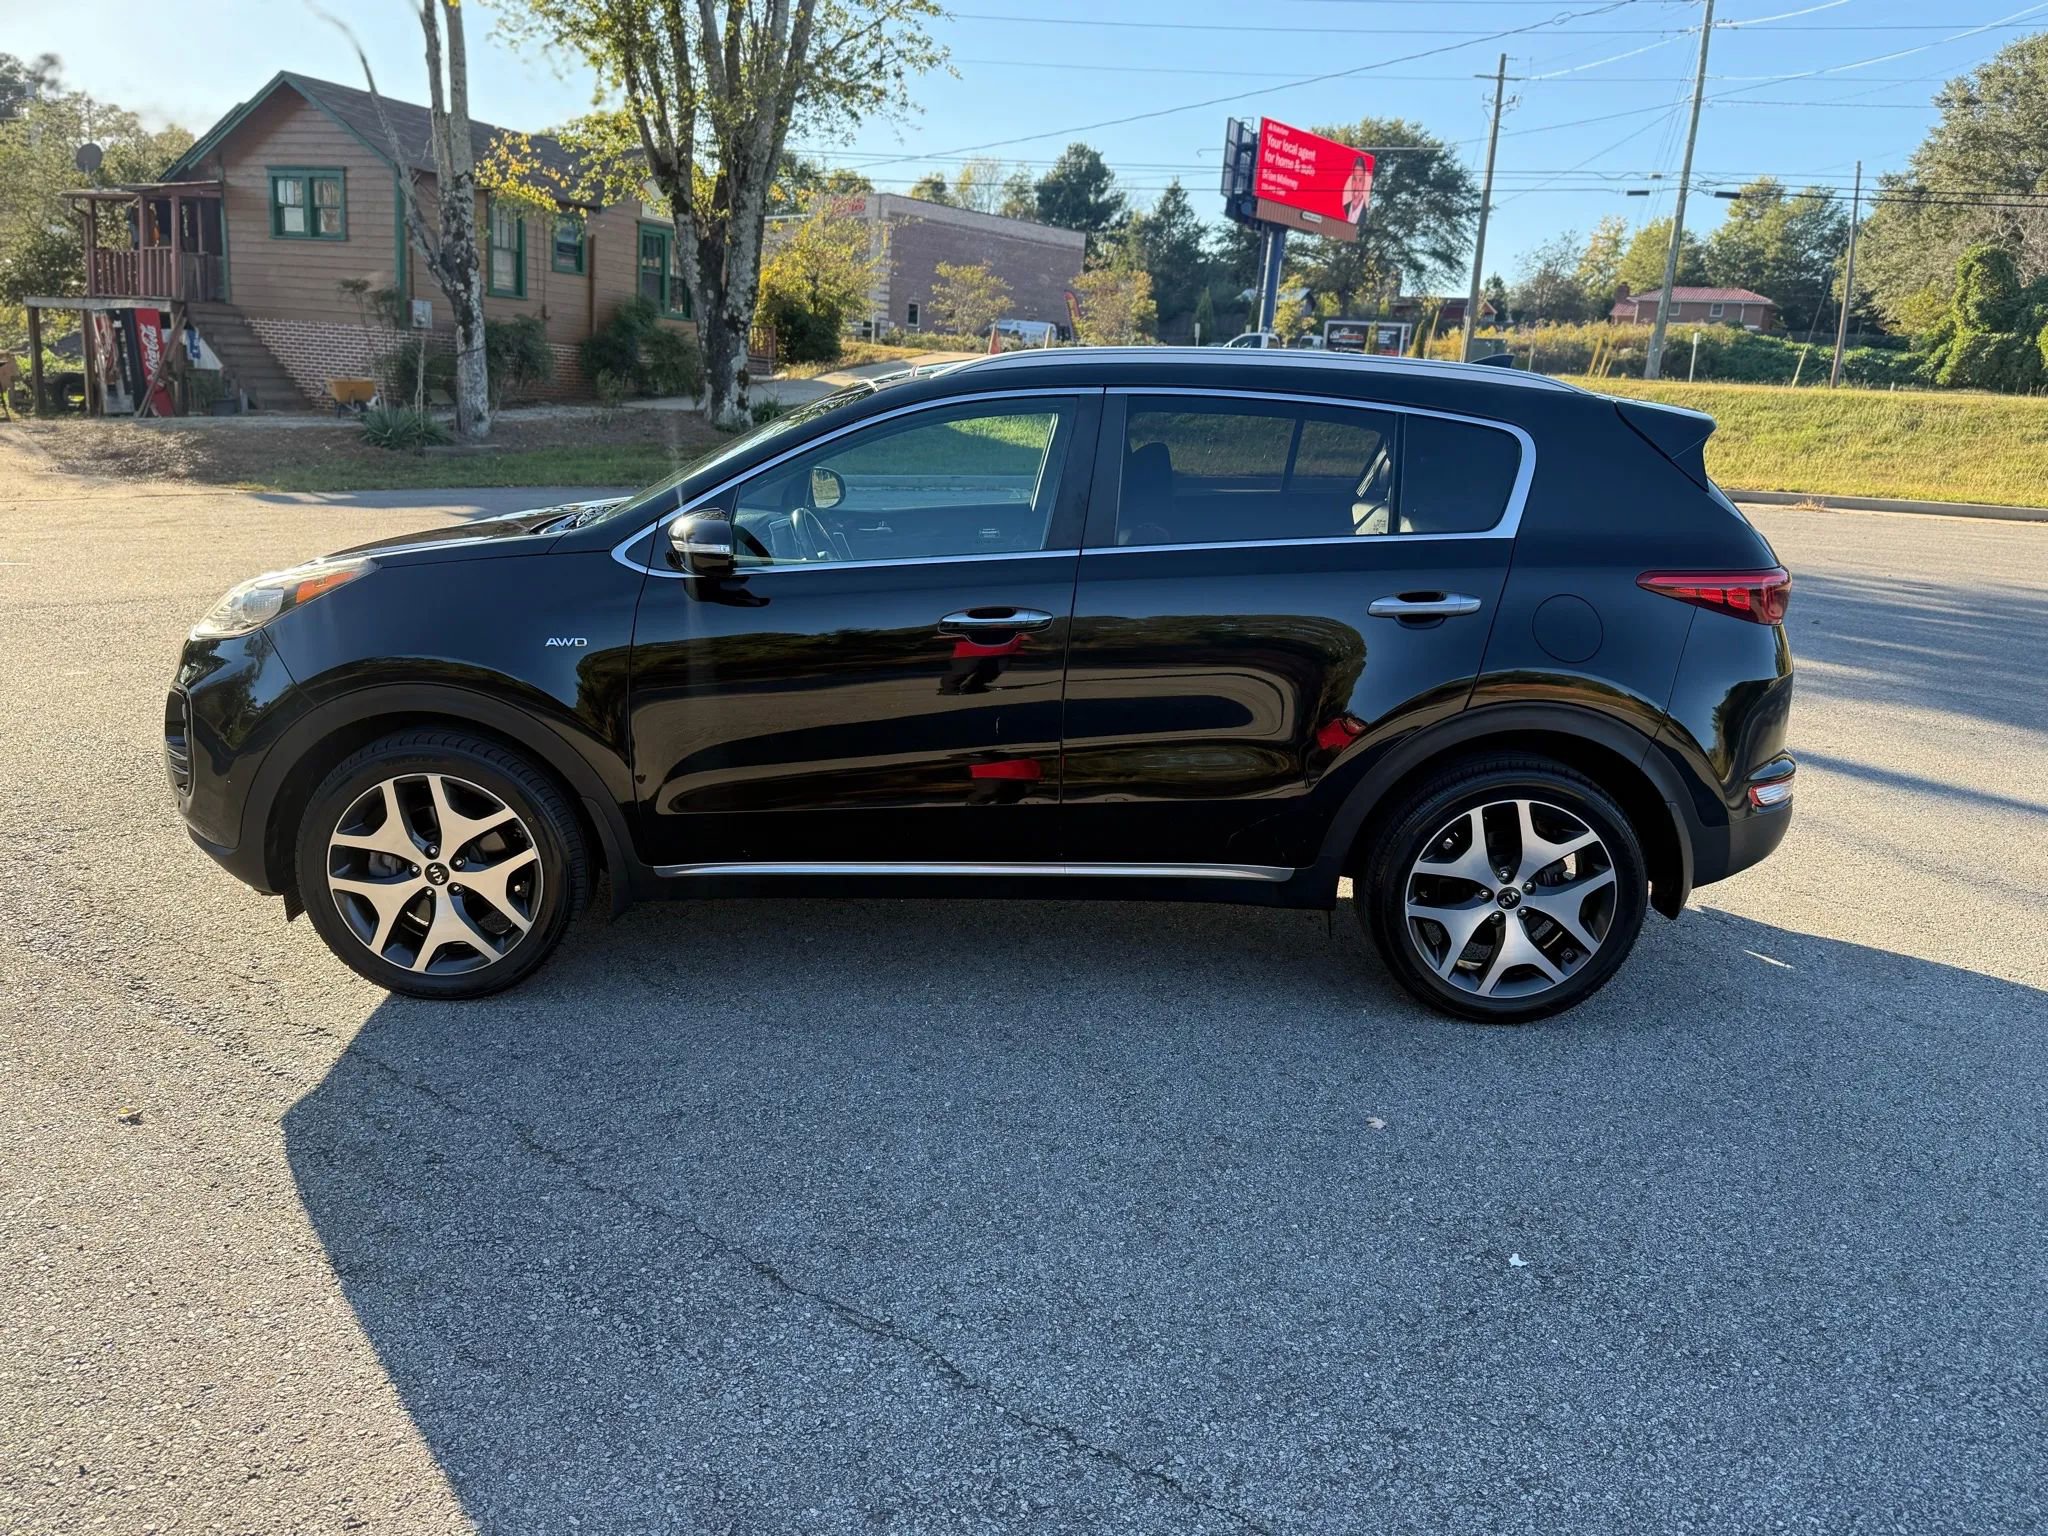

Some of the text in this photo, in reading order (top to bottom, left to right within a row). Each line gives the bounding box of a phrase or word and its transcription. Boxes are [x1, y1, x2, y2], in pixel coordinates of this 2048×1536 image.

[1267, 133, 1316, 162] Your local agent
[1264, 149, 1275, 163] for
[1275, 152, 1294, 169] home
[140, 323, 160, 371] Coca-Cola
[545, 637, 588, 647] AWD
[430, 864, 445, 884] KIA
[1500, 891, 1519, 907] KIA
